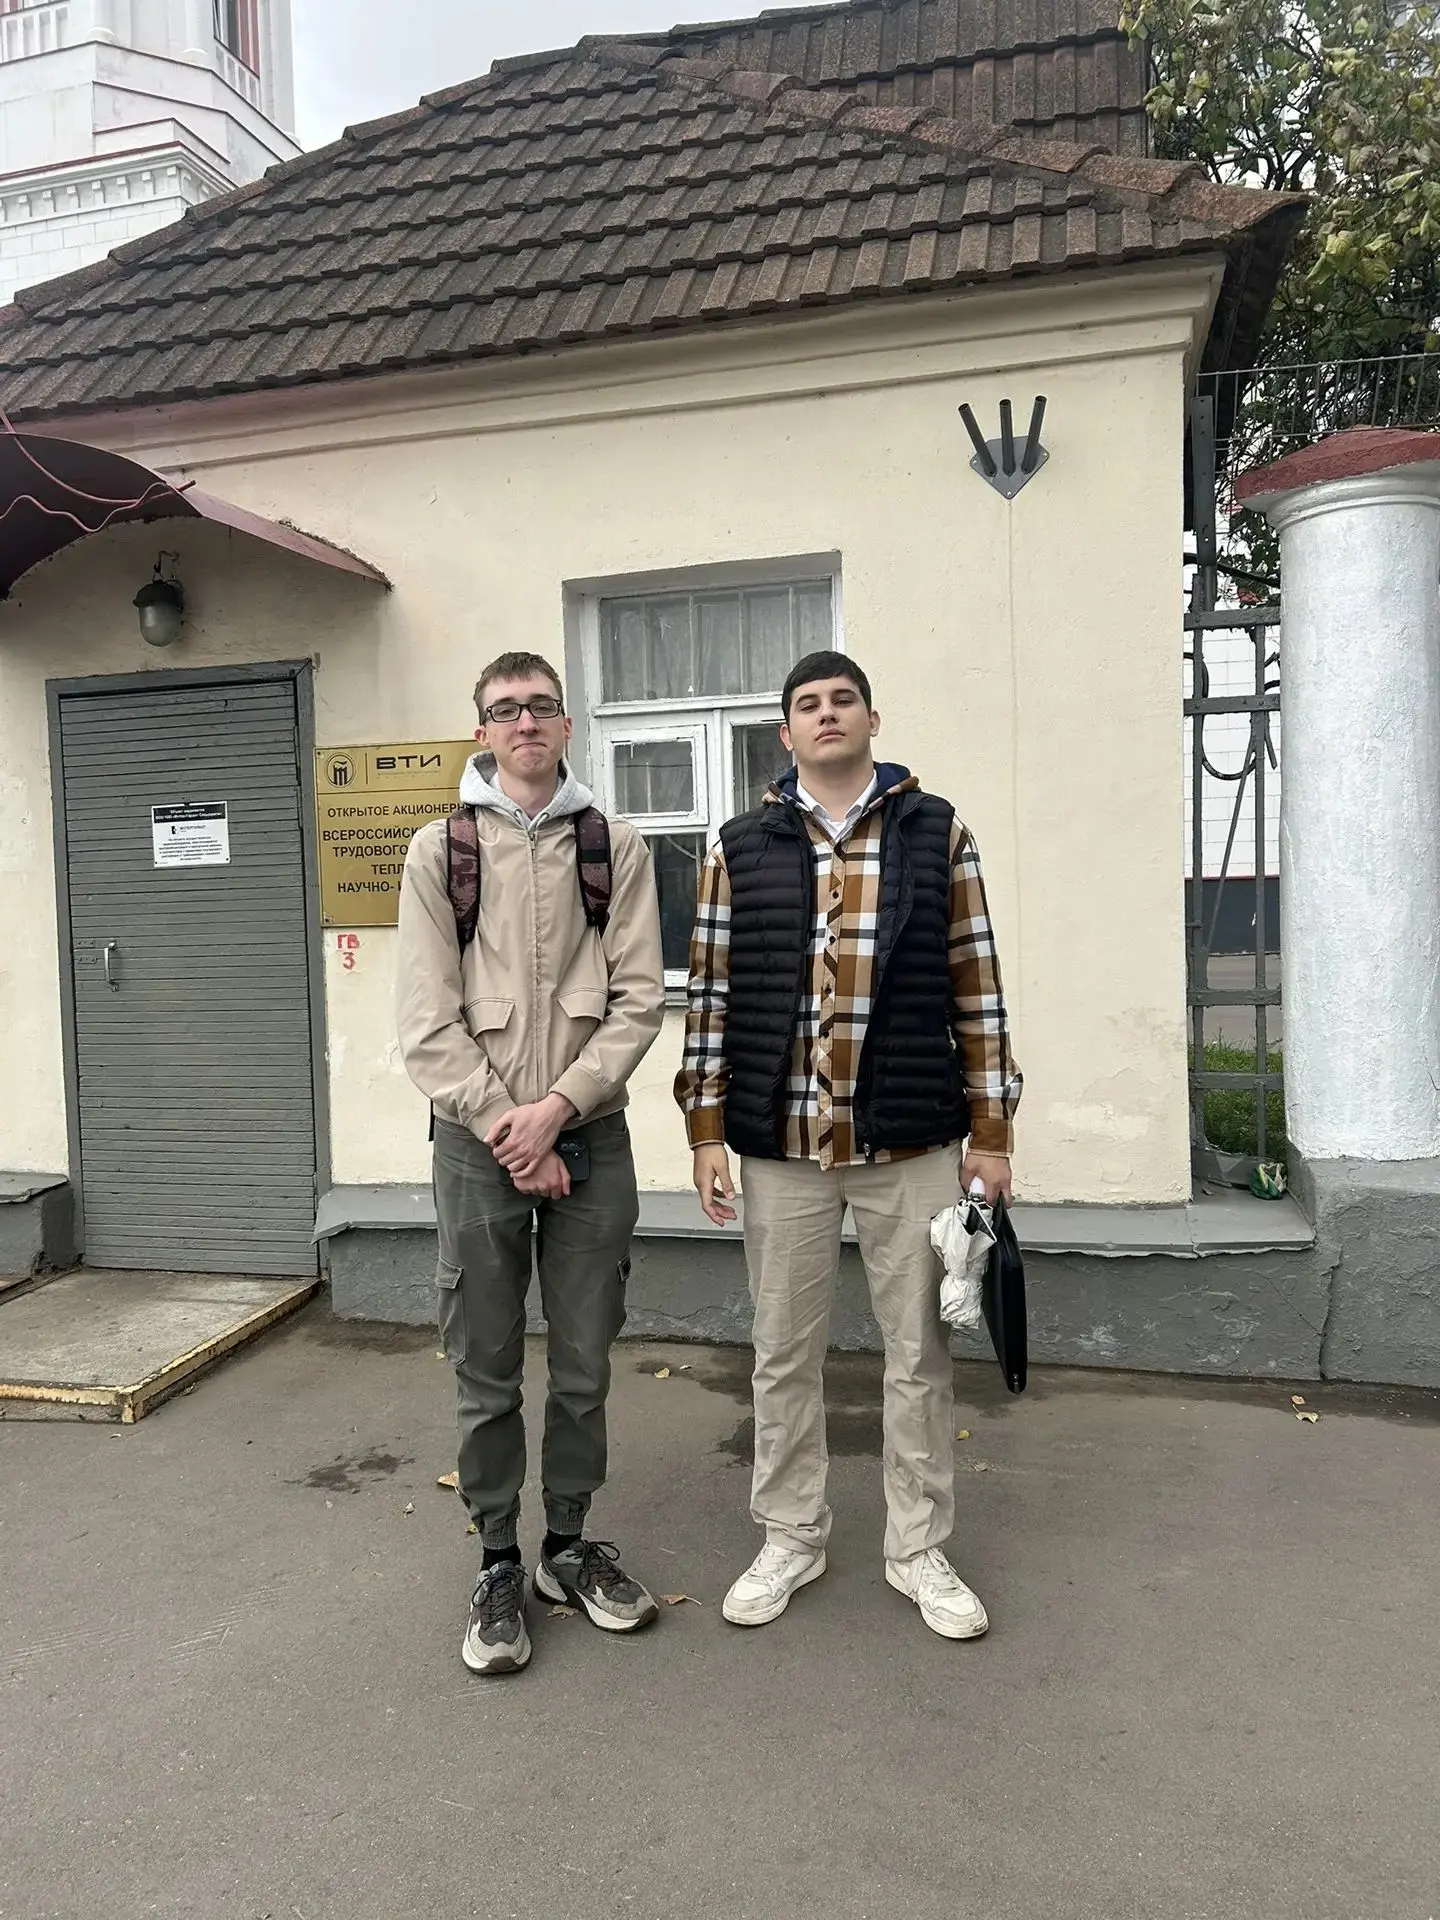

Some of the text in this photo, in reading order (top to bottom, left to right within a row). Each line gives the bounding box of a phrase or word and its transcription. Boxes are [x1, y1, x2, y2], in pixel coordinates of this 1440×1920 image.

[376, 754, 441, 770] ВТИ
[327, 803, 466, 818] ОТКРЫТОЕ АКЦИОНЕРН
[322, 825, 421, 841] ВСЕРОССИЙСК
[332, 844, 409, 858] ТРУДОВОГО
[337, 881, 395, 893] НАУЧНО-
[337, 934, 360, 949] ГВ
